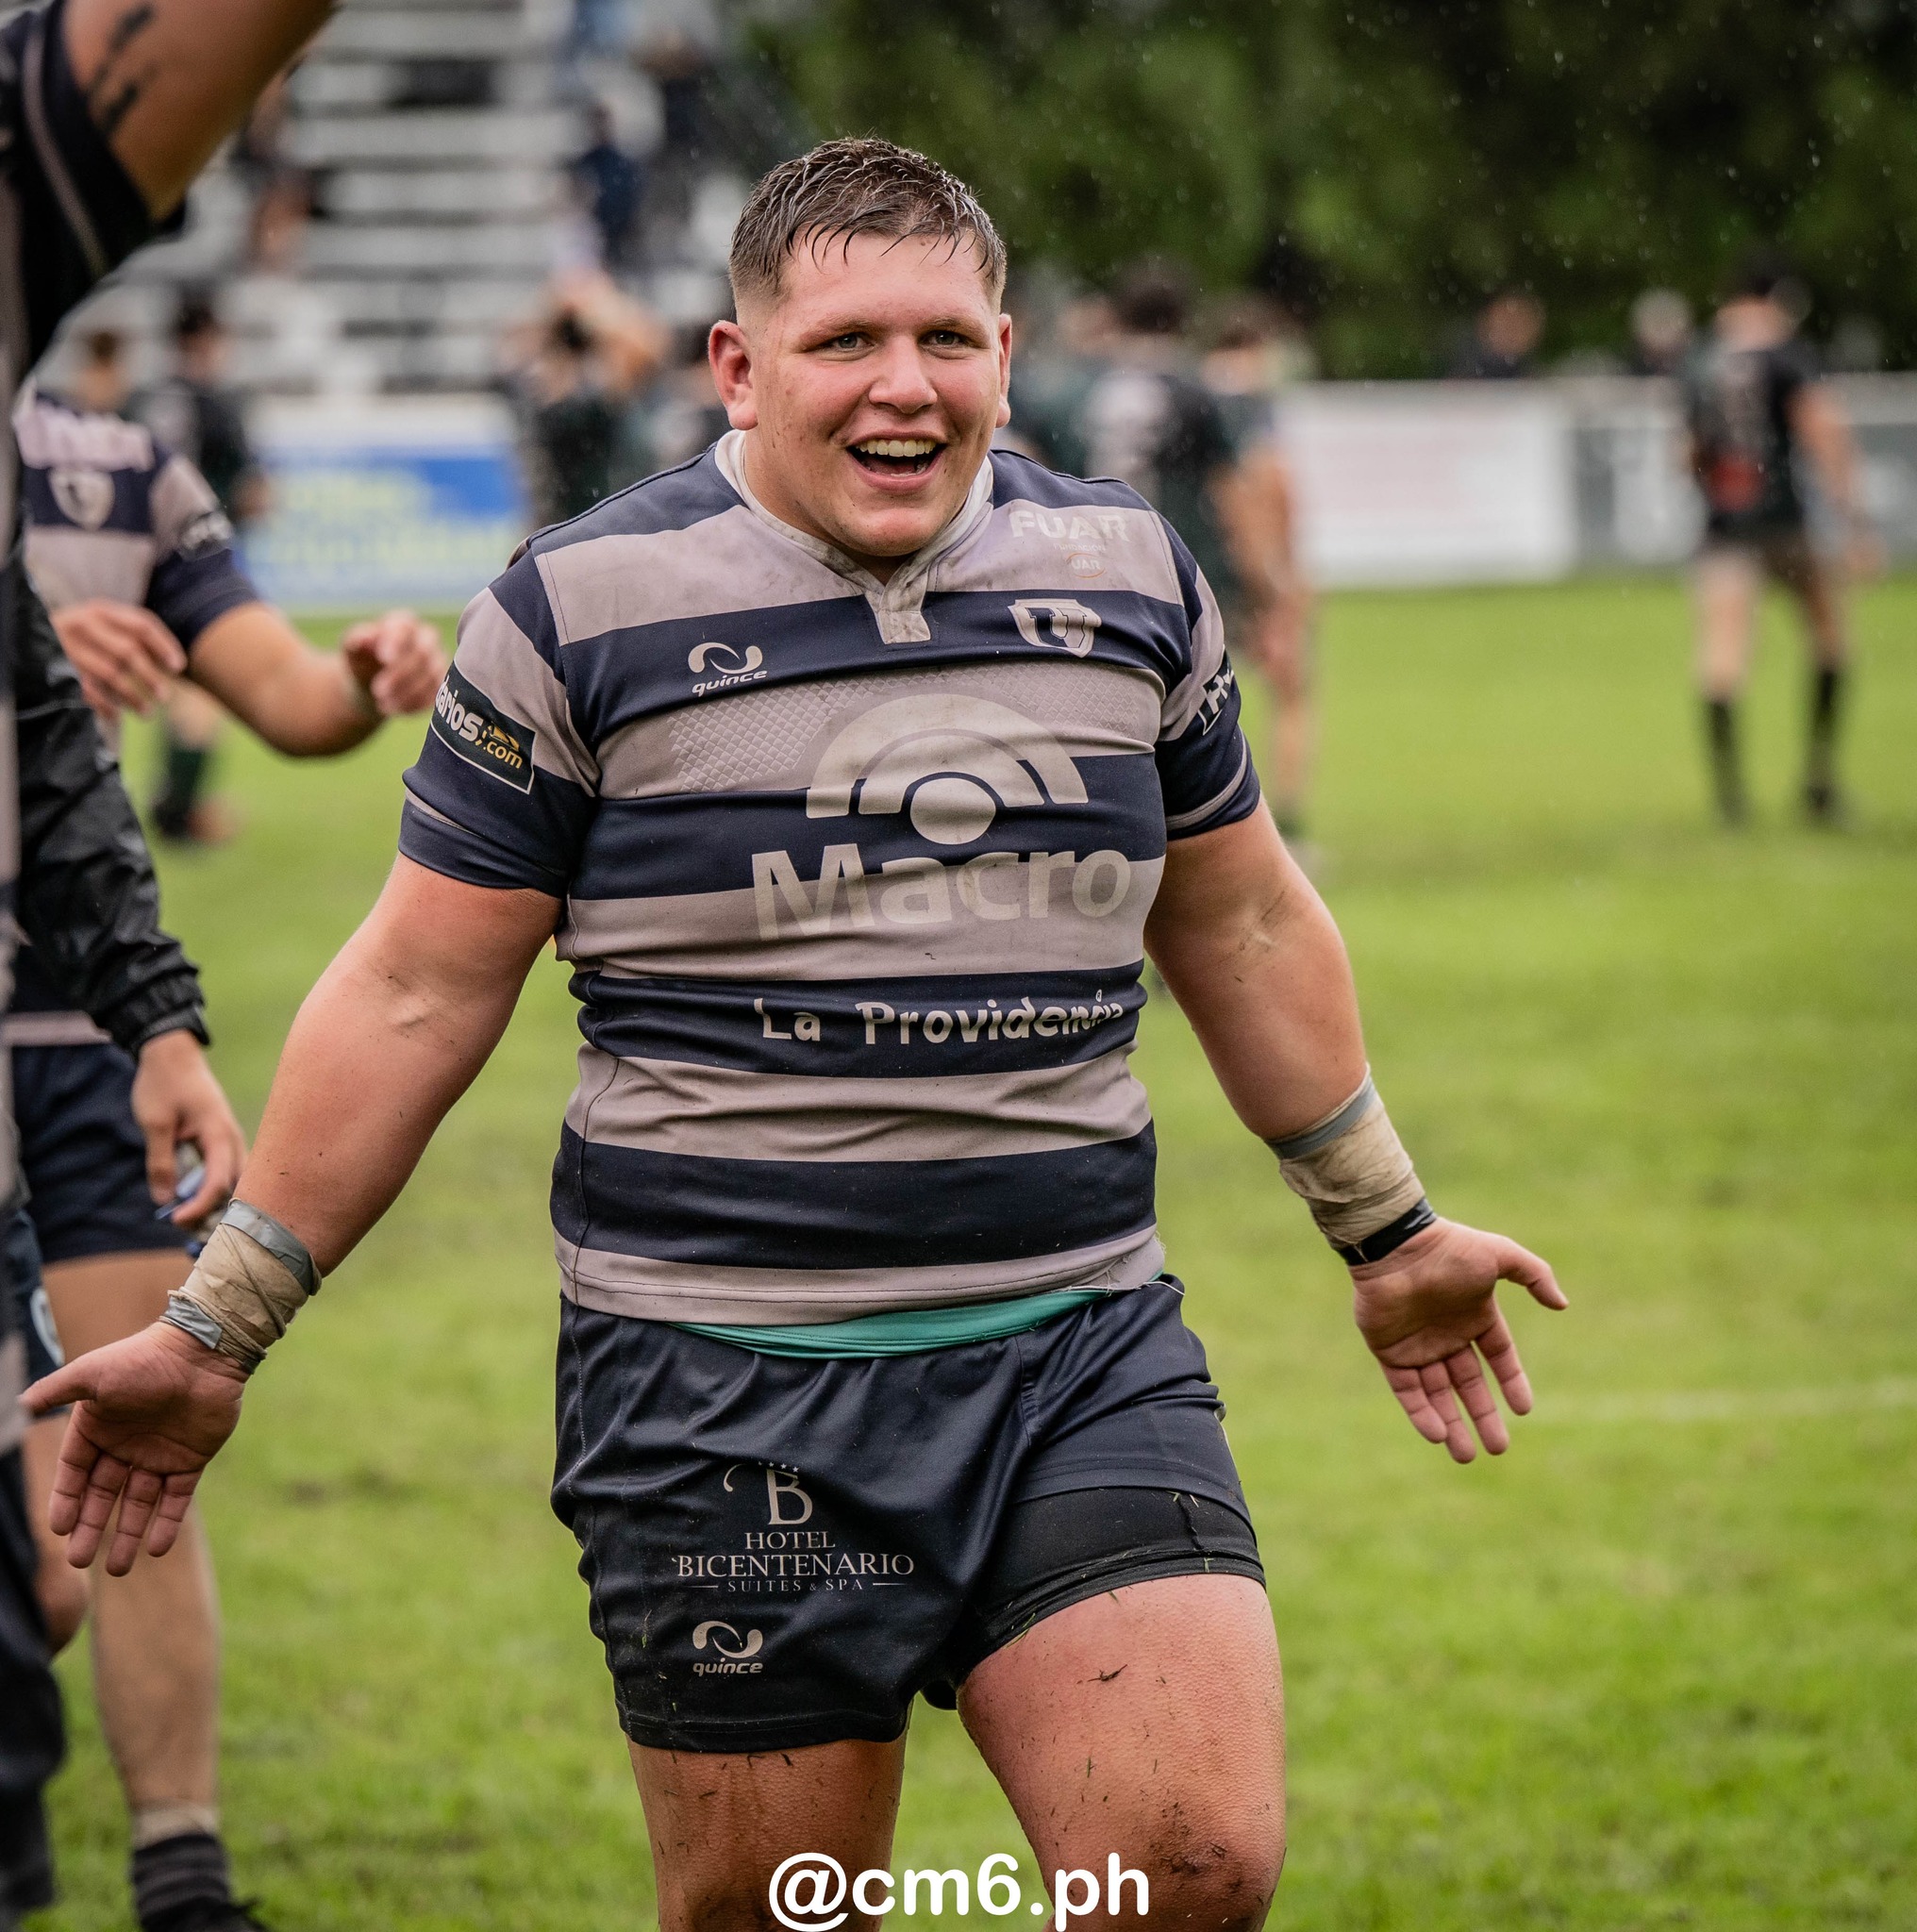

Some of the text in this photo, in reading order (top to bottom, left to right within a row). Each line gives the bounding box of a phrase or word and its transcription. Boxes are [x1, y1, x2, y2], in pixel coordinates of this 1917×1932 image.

[1008, 510, 1130, 542] FUAR
[1071, 558, 1101, 571] UAR
[692, 670, 768, 697] quince
[752, 842, 1131, 941] Macro
[754, 998, 821, 1041] La
[744, 1531, 836, 1550] HOTEL
[671, 1553, 915, 1578] BICENTENARIO
[727, 1579, 801, 1592] SUITES
[825, 1578, 863, 1591] SPA
[692, 1657, 763, 1676] quince
